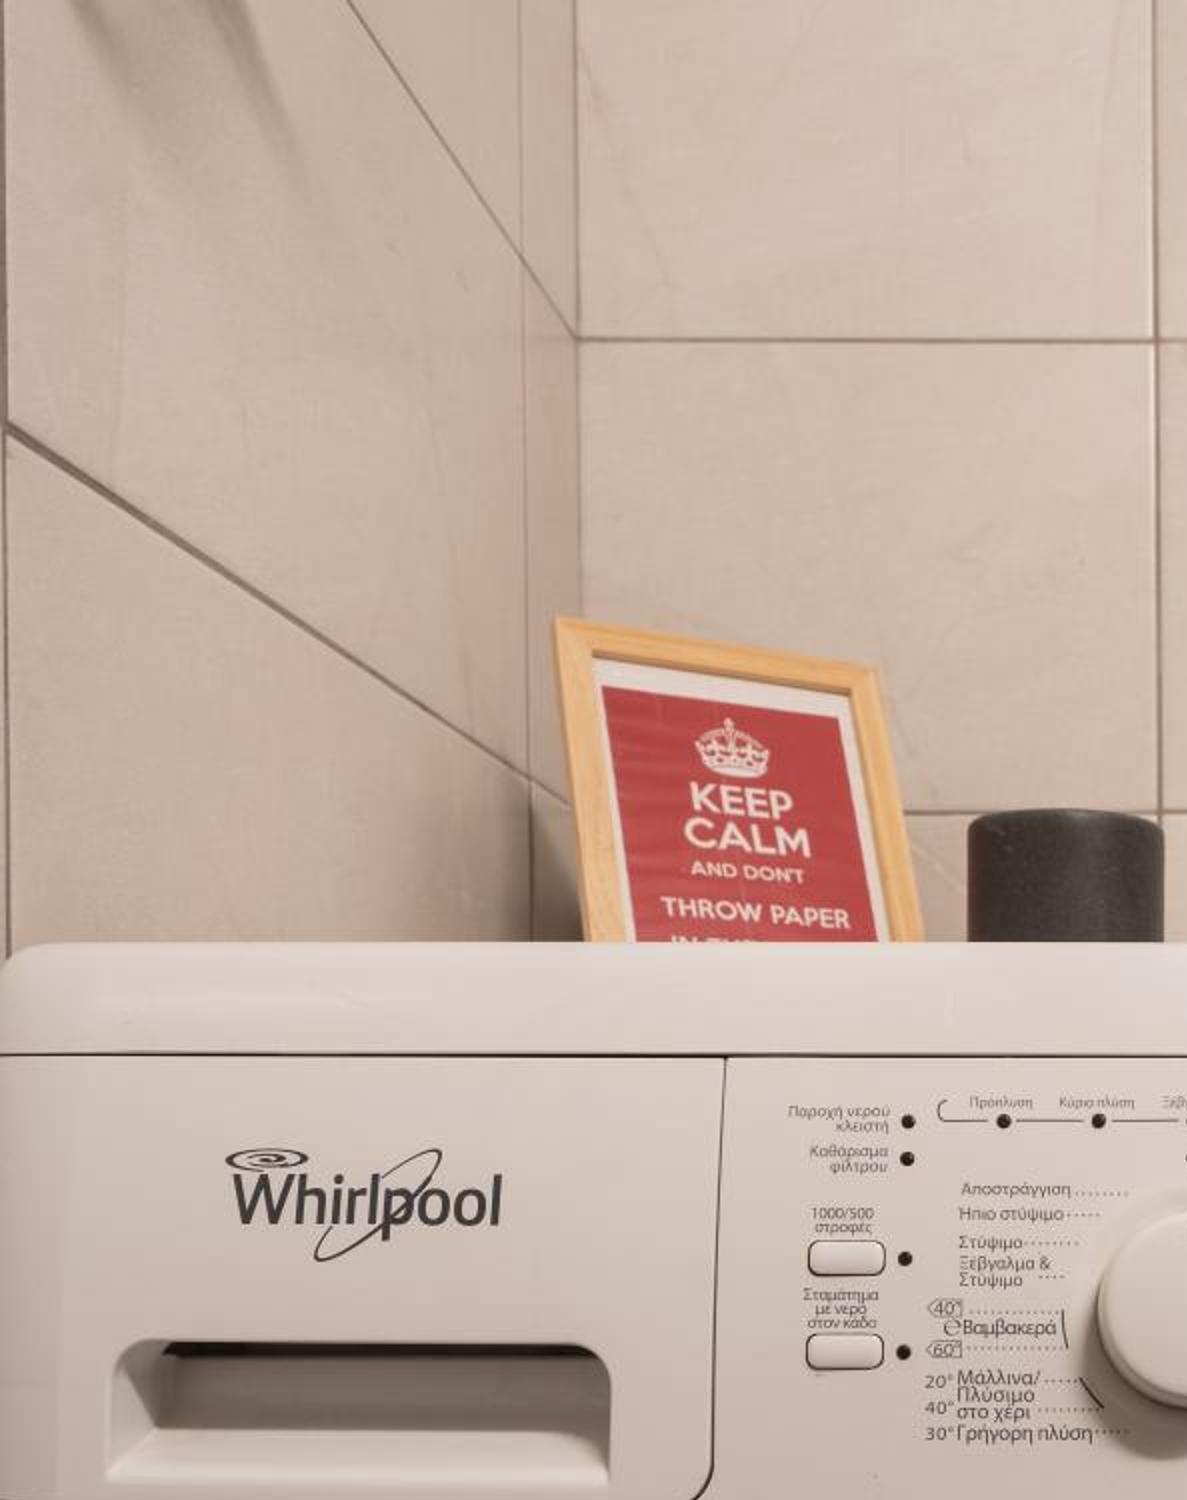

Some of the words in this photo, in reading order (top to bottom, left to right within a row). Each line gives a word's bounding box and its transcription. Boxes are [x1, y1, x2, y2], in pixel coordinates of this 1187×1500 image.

[690, 781, 793, 819] KEEP
[684, 819, 811, 858] CALM
[691, 860, 737, 878] AND
[743, 864, 804, 883] DON'T
[660, 896, 761, 923] THROW
[770, 905, 850, 929] PAPER
[788, 1105, 842, 1120] Παροχή
[847, 1105, 890, 1119] νερού
[836, 1120, 888, 1134] κλειστή
[810, 1144, 888, 1160] Καθάρισμα
[961, 1182, 1071, 1199] Αποστράγγιση
[233, 1173, 502, 1241] Whirlpool
[811, 1206, 875, 1220] 1000/500
[1000, 1205, 1064, 1224] στύψιμο
[815, 1222, 873, 1235] στροφές
[959, 1236, 1023, 1252] Στύψιμο
[1039, 1256, 1051, 1270] &
[960, 1272, 1023, 1290] Στύψιμο
[815, 1306, 831, 1317] με
[808, 1318, 840, 1328] στον
[963, 1320, 1057, 1338] Βαμβακερά
[925, 1374, 953, 1388] 20°
[957, 1370, 1040, 1386] Μάλλινα/
[957, 1386, 1035, 1405] Πλύσιμο
[925, 1400, 955, 1415] 40°
[957, 1407, 988, 1419] στο
[994, 1405, 1030, 1422] χέρι
[926, 1427, 955, 1441] 30°
[957, 1426, 1033, 1445] Γρήγορη
[1037, 1426, 1093, 1445] πλύση
